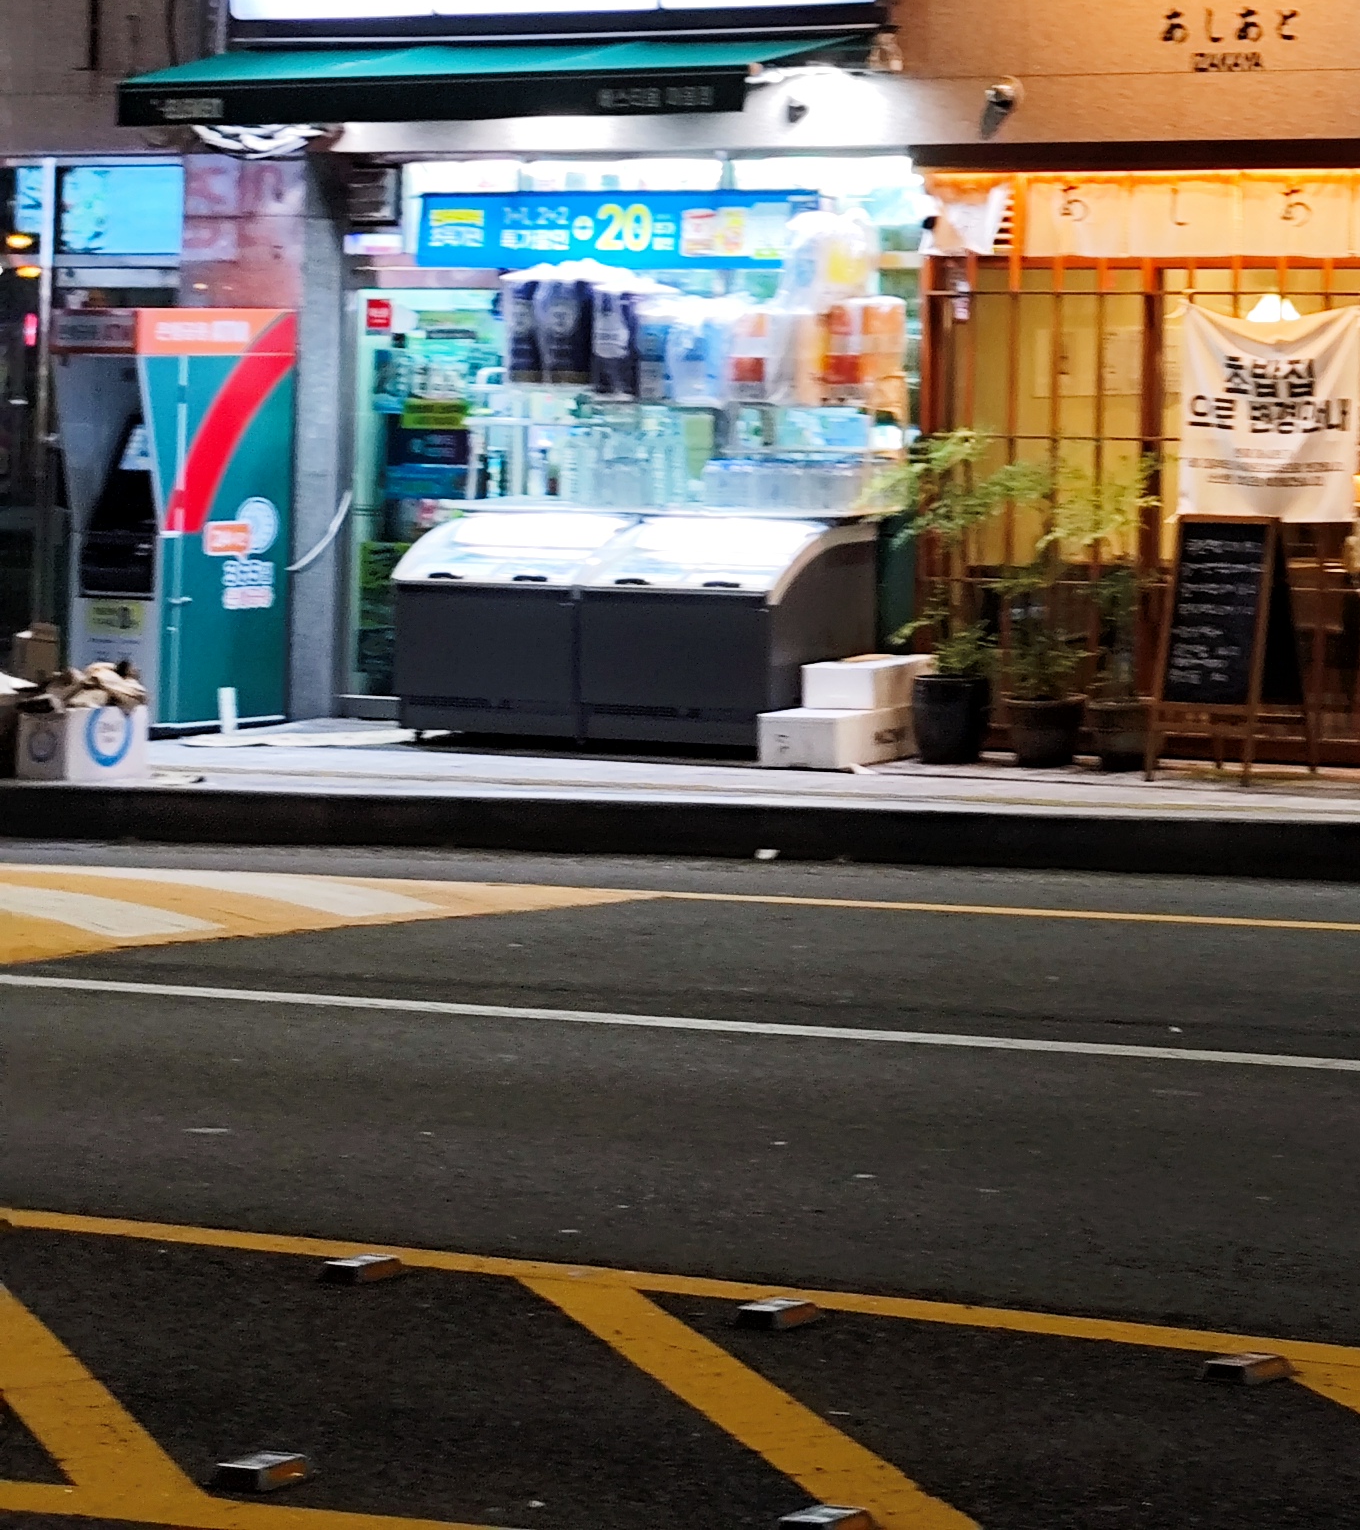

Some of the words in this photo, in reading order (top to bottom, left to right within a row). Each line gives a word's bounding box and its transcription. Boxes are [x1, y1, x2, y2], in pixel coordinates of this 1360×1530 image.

[1160, 7, 1300, 44] あしおと
[595, 203, 653, 252] 20
